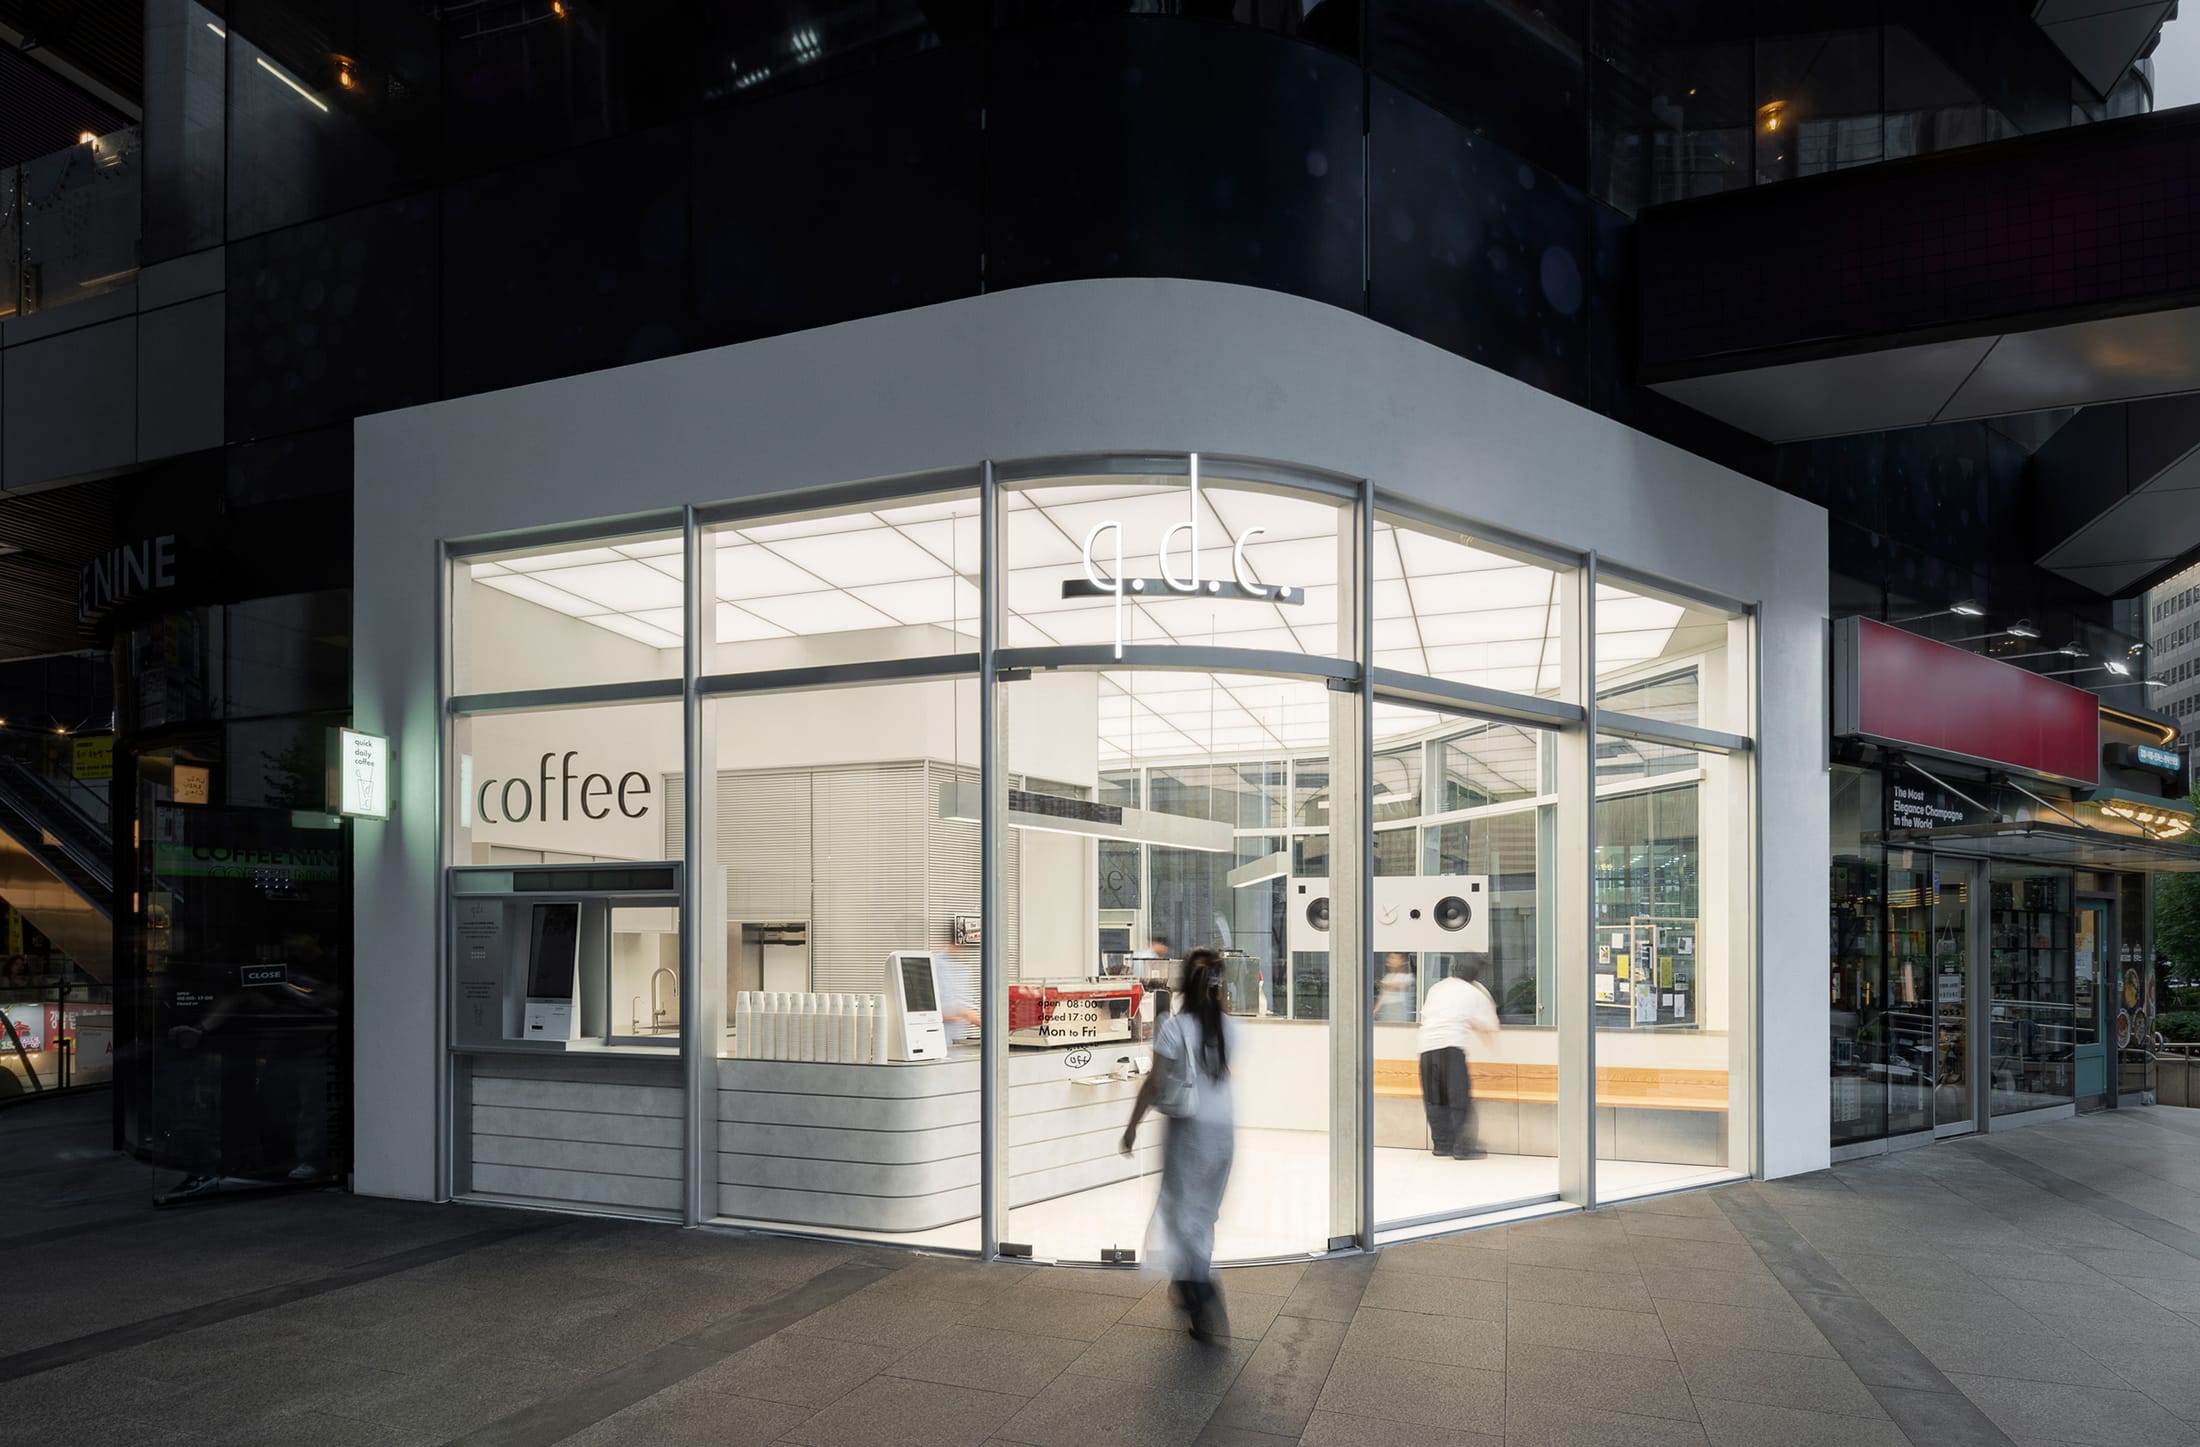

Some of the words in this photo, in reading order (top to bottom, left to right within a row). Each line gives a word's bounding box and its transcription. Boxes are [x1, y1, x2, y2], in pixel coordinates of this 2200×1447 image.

[355, 740, 371, 755] quick
[355, 749, 371, 758] daily
[354, 758, 375, 767] coffee
[477, 751, 652, 824] coffee
[1894, 786, 1906, 798] The
[1908, 788, 1923, 800] Most
[1894, 800, 1924, 815] Elegance
[1894, 814, 1900, 825] in
[1901, 815, 1913, 828] the
[1913, 817, 1932, 829] World
[247, 970, 282, 981] CLOSE
[1067, 1000, 1097, 1008] 08:00
[1038, 1013, 1065, 1021] closed
[1069, 1013, 1097, 1021] 17:00
[1039, 1026, 1065, 1036] Mon
[1082, 1026, 1096, 1036] Fri
